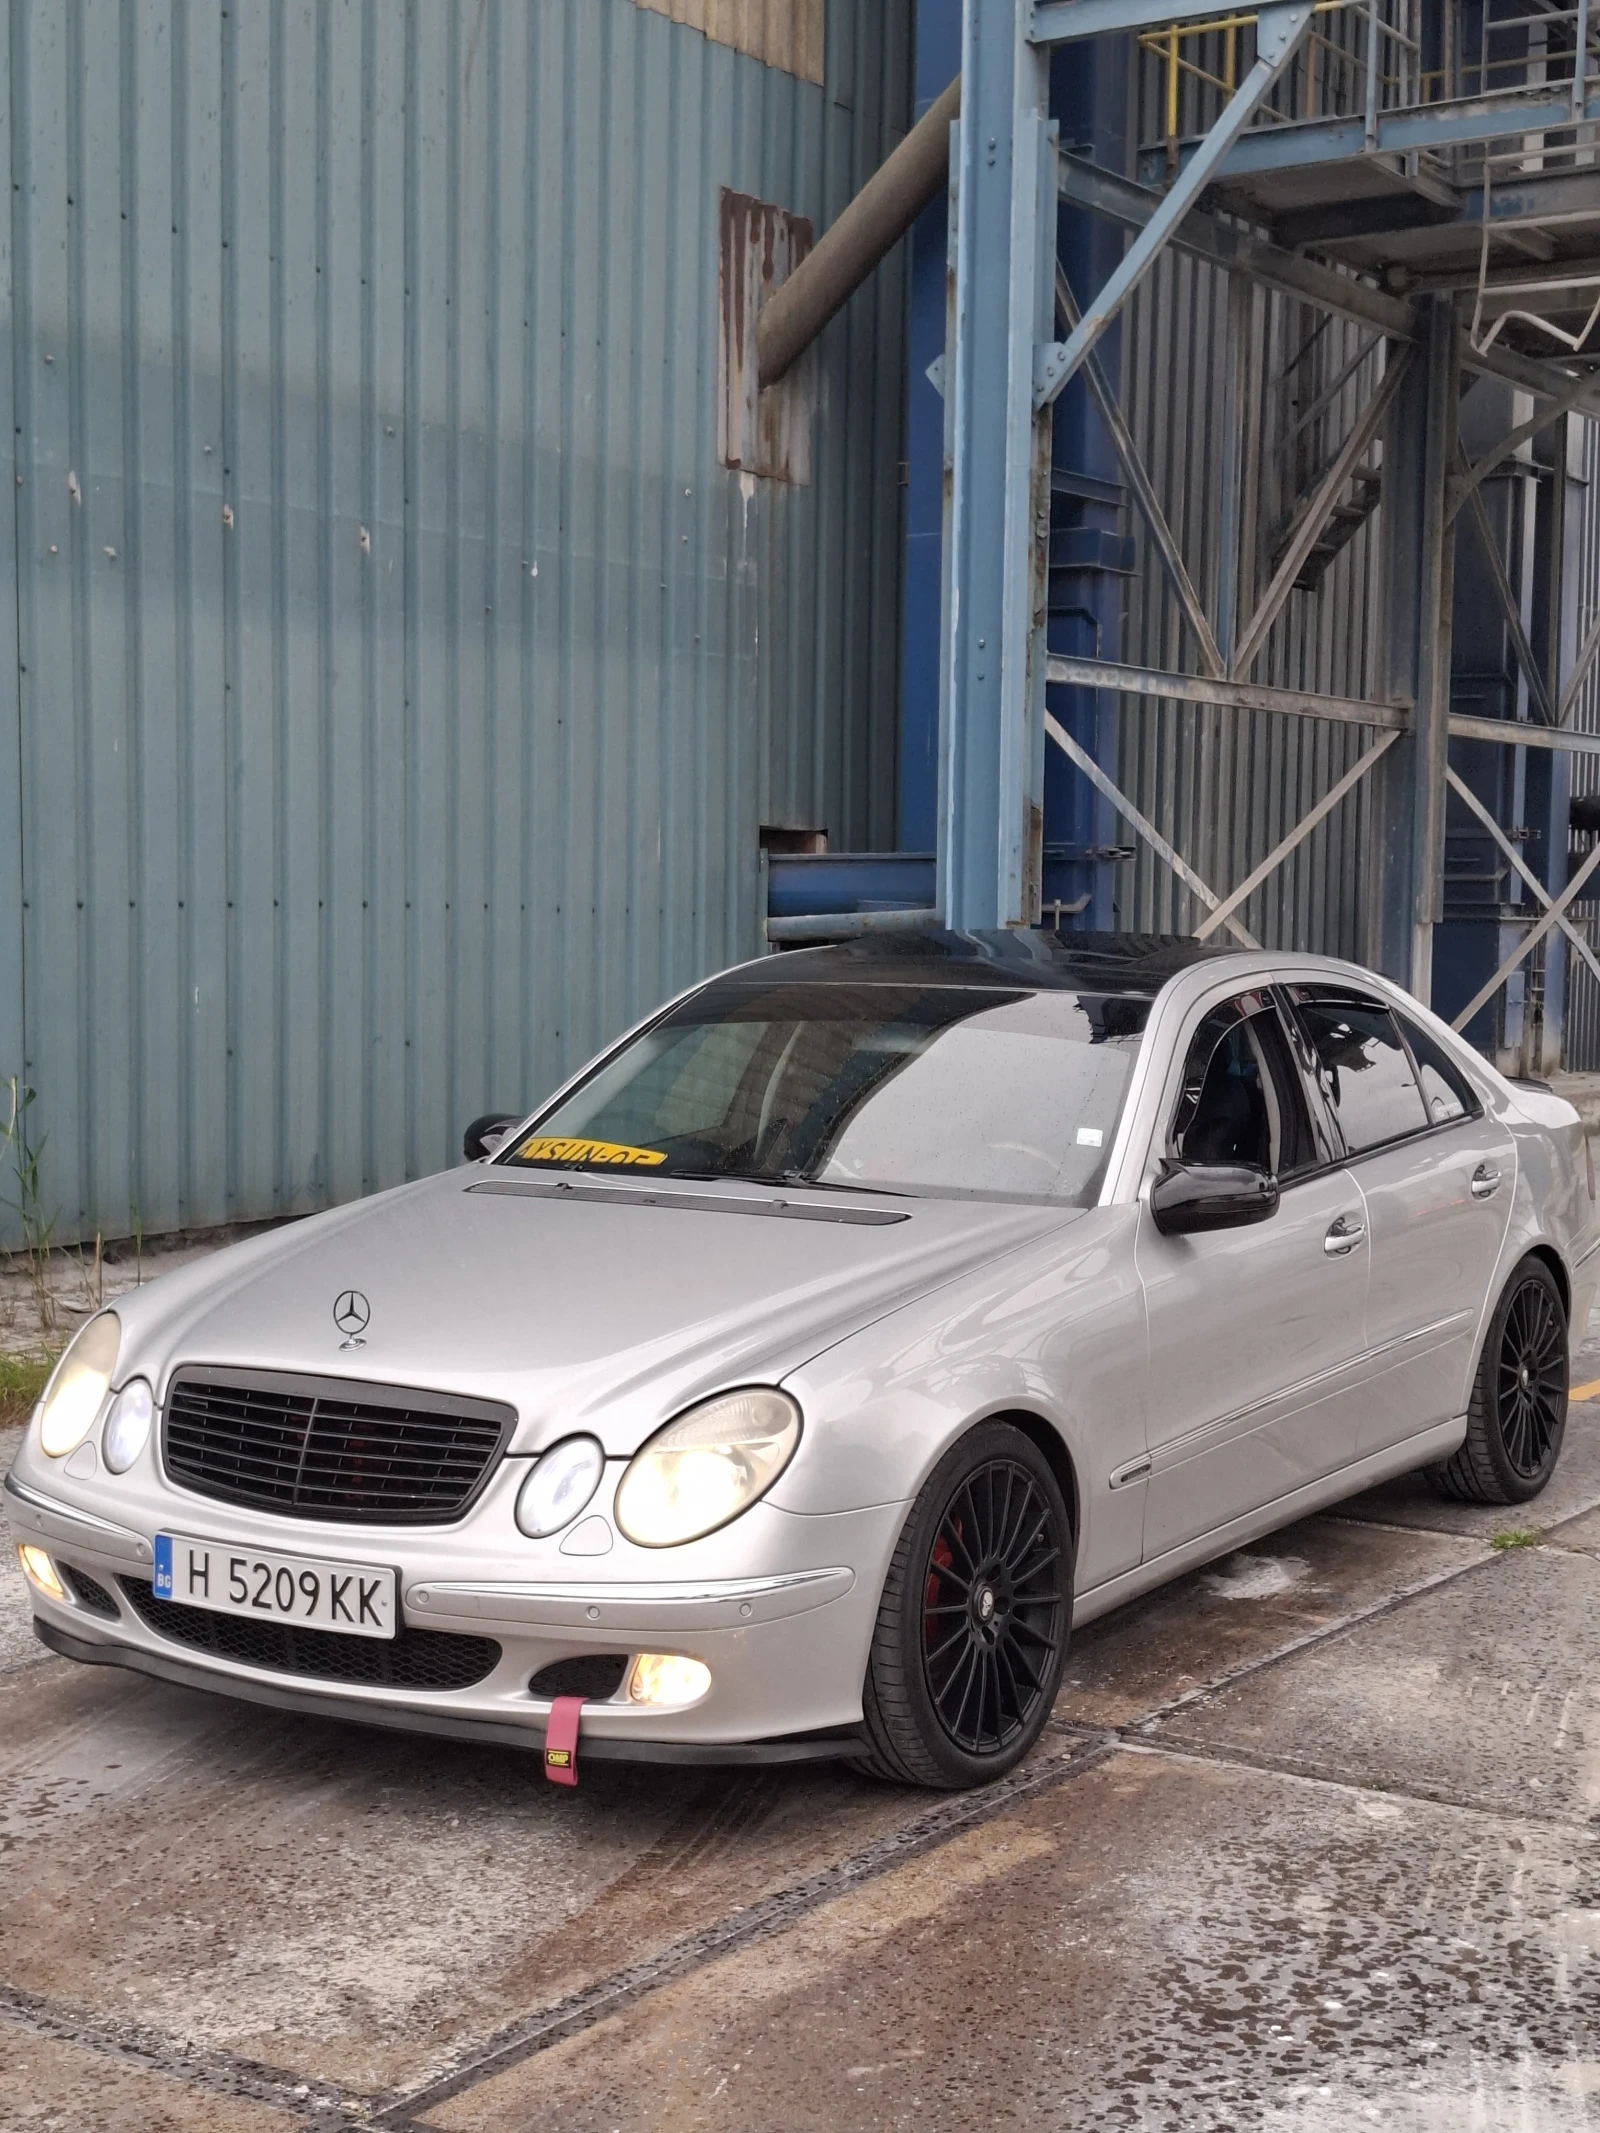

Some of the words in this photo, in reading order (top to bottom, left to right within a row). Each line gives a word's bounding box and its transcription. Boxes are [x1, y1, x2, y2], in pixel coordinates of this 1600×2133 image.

[157, 1573, 171, 1588] BG
[189, 1550, 210, 1598] H
[229, 1557, 321, 1616] 5209
[331, 1573, 384, 1627] KK
[548, 1753, 569, 1763] OMP
